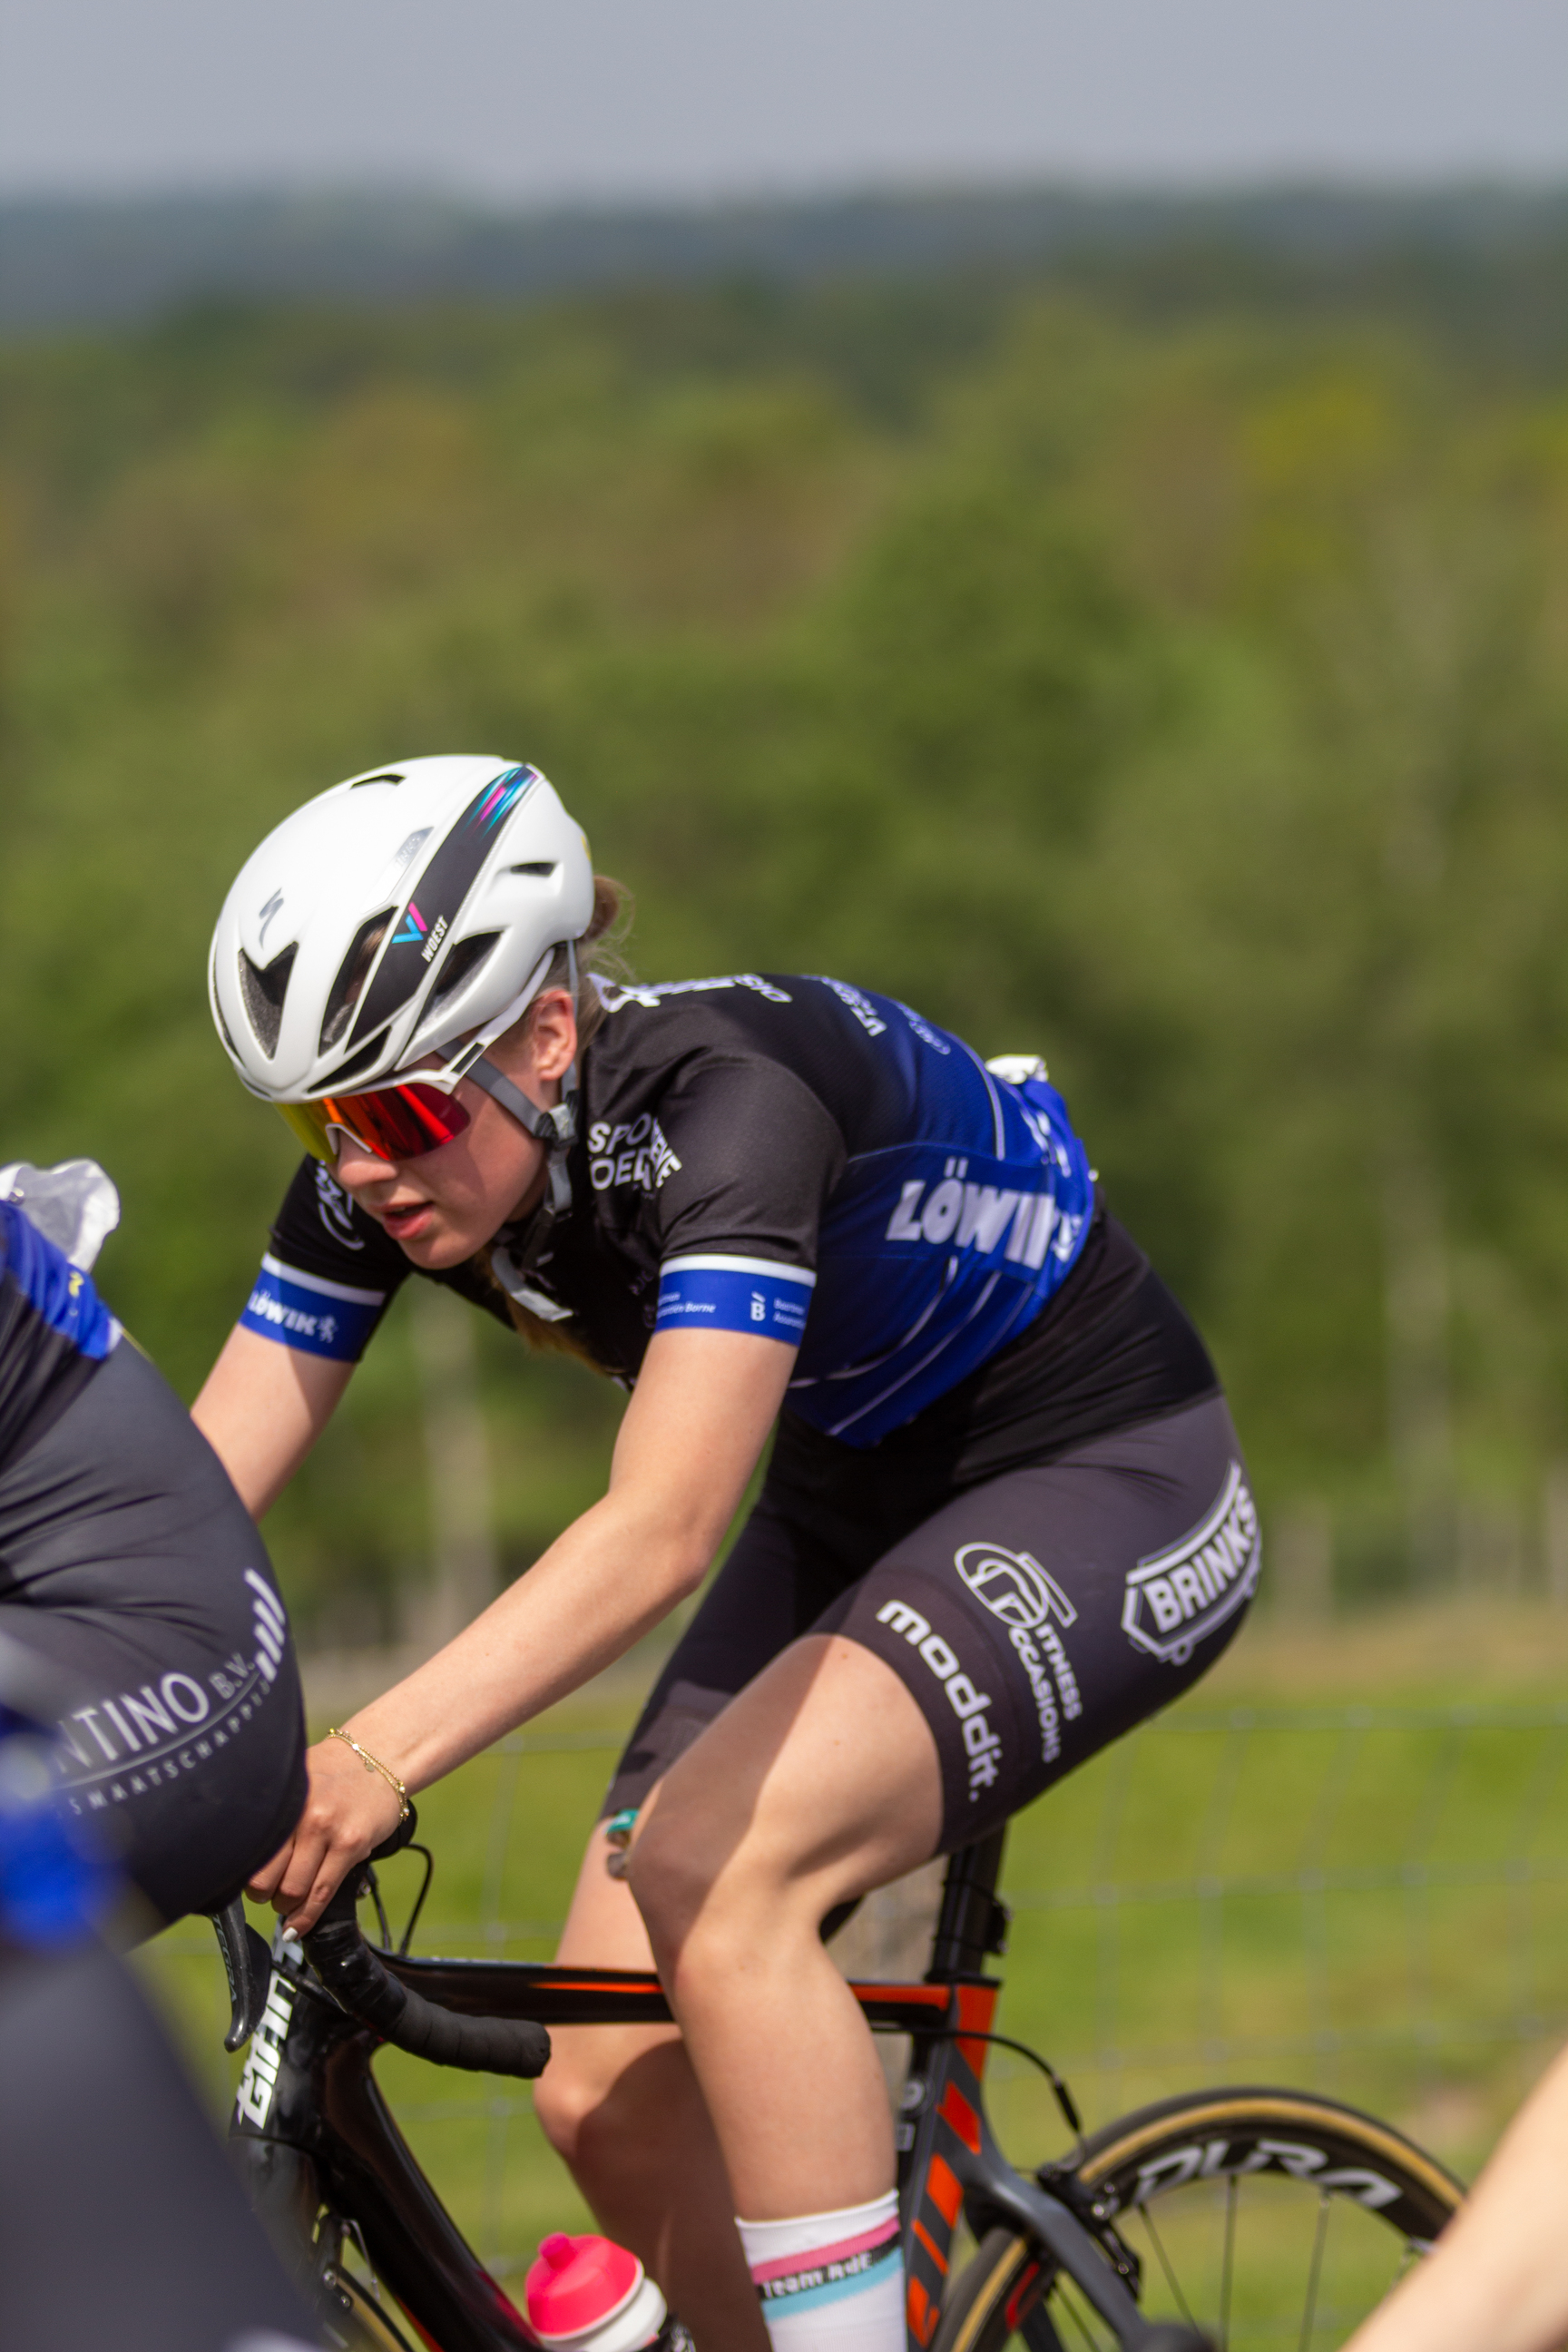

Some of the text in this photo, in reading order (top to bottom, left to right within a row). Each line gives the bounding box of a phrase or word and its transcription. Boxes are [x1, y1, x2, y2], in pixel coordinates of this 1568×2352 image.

[421, 915, 448, 963] WOEST
[209, 1652, 255, 1700] B.V.
[1134, 2139, 1402, 2209] DURA
